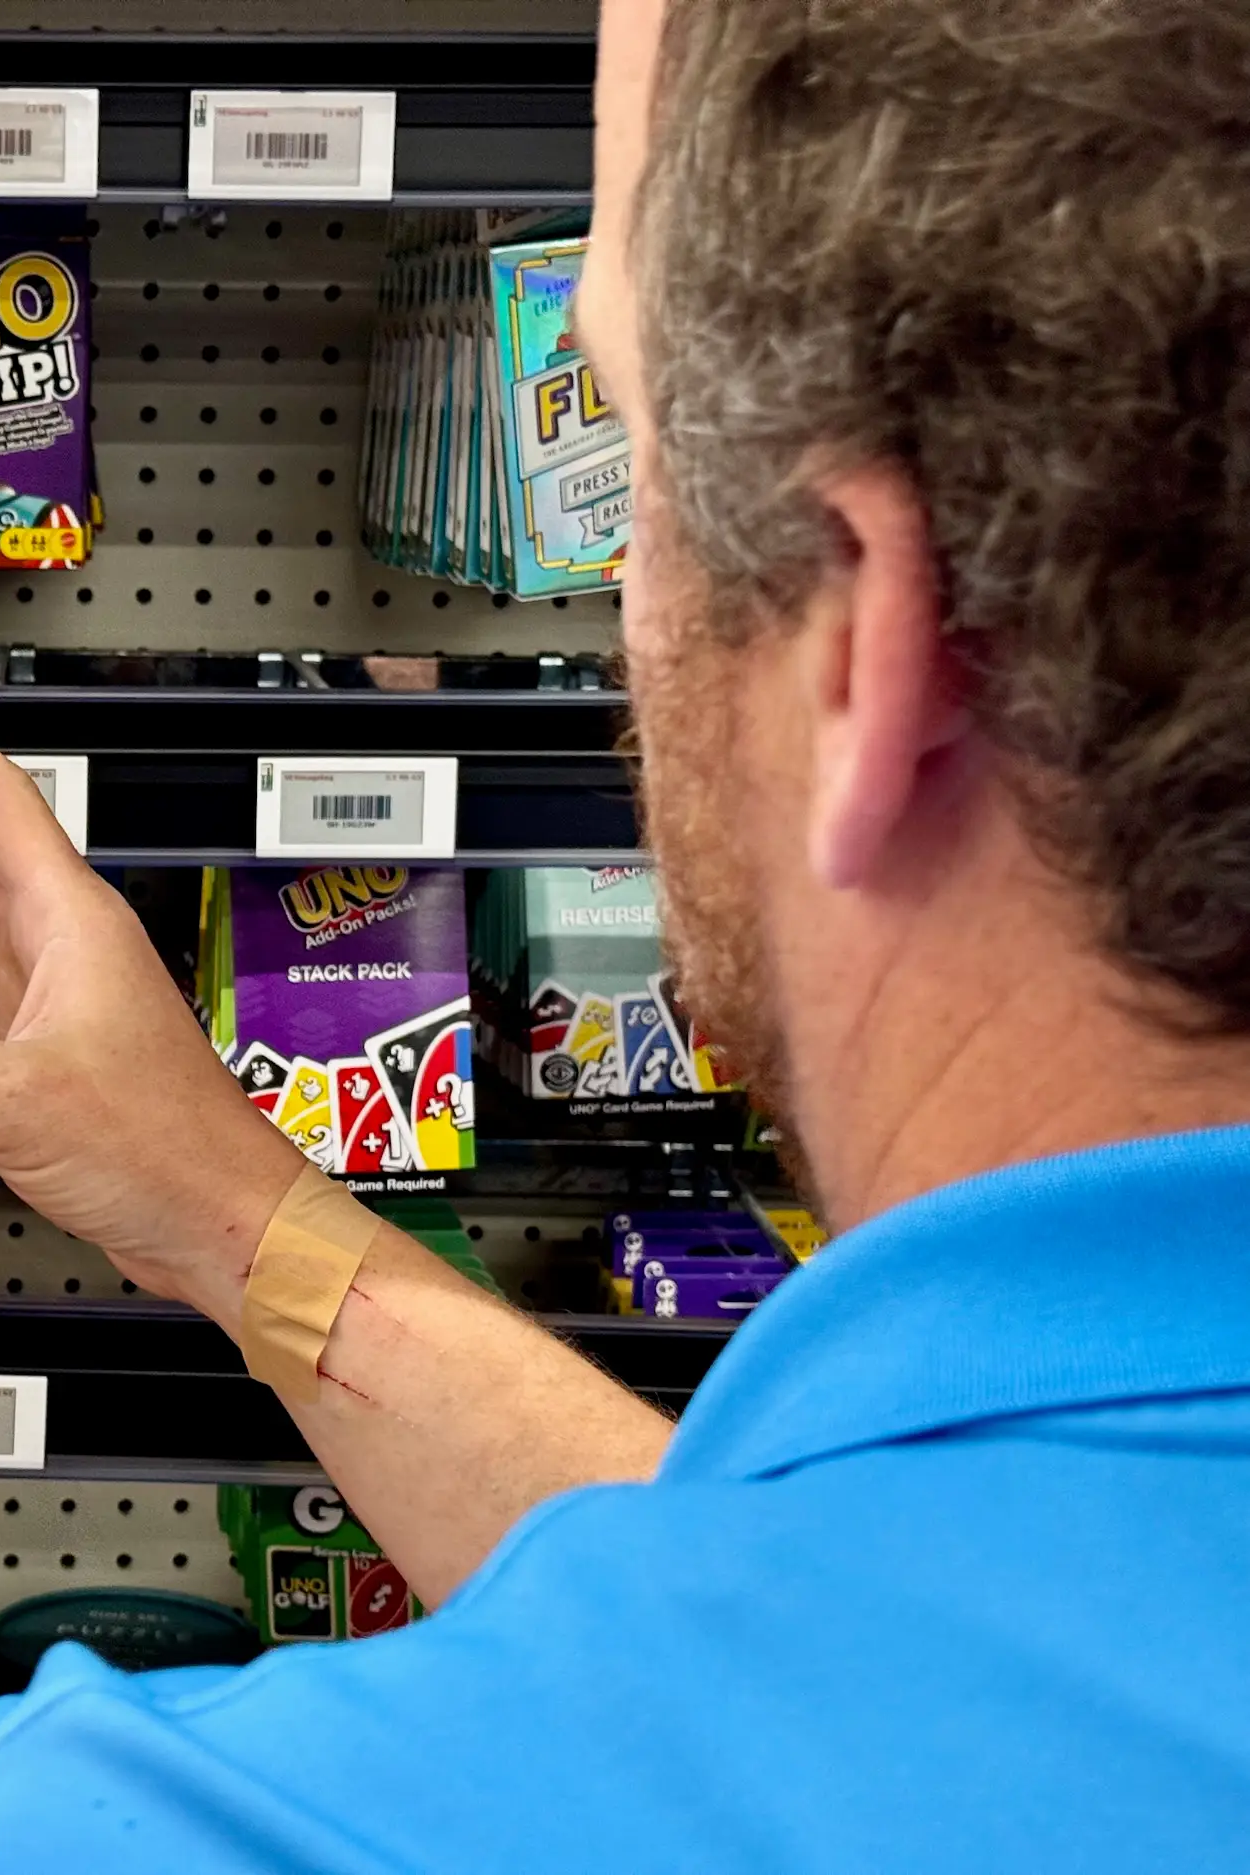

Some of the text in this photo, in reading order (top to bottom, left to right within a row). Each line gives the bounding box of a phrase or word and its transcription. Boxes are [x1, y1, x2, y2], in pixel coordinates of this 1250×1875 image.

[573, 466, 620, 498] PRESS
[278, 867, 408, 932] UNO
[306, 893, 417, 950] Add-On Packs!
[287, 961, 413, 984] STACK PACK
[603, 1101, 629, 1113] Card
[631, 1099, 665, 1112] Game
[666, 1098, 715, 1111] Required
[346, 1175, 446, 1192] Game Required
[280, 1576, 326, 1594] UNO
